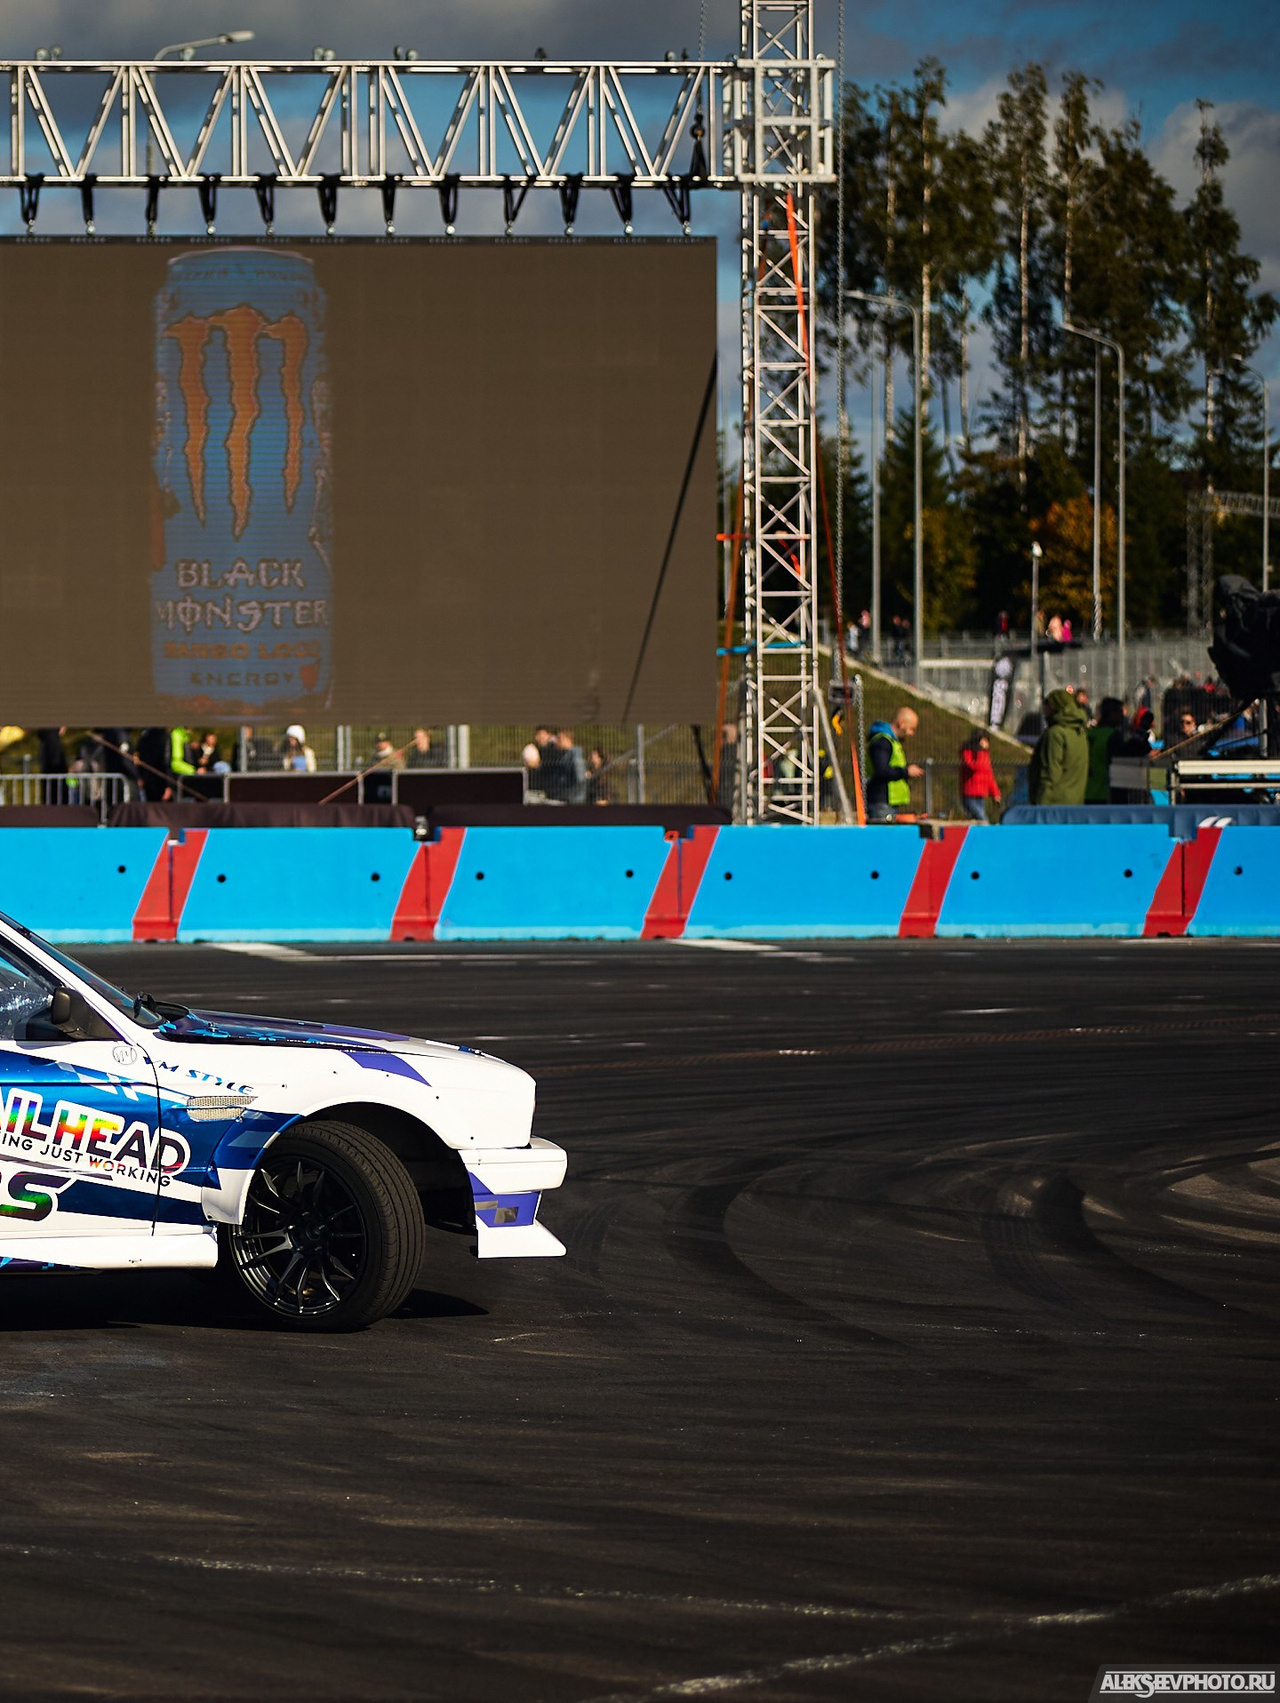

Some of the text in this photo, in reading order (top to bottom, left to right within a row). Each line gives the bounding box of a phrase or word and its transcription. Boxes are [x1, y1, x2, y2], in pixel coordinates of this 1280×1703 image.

[176, 558, 305, 588] BLACK
[189, 672, 294, 687] ENERGY
[185, 1069, 255, 1095] STYLE
[40, 1144, 83, 1164] JUST
[89, 1155, 170, 1188] WORKING
